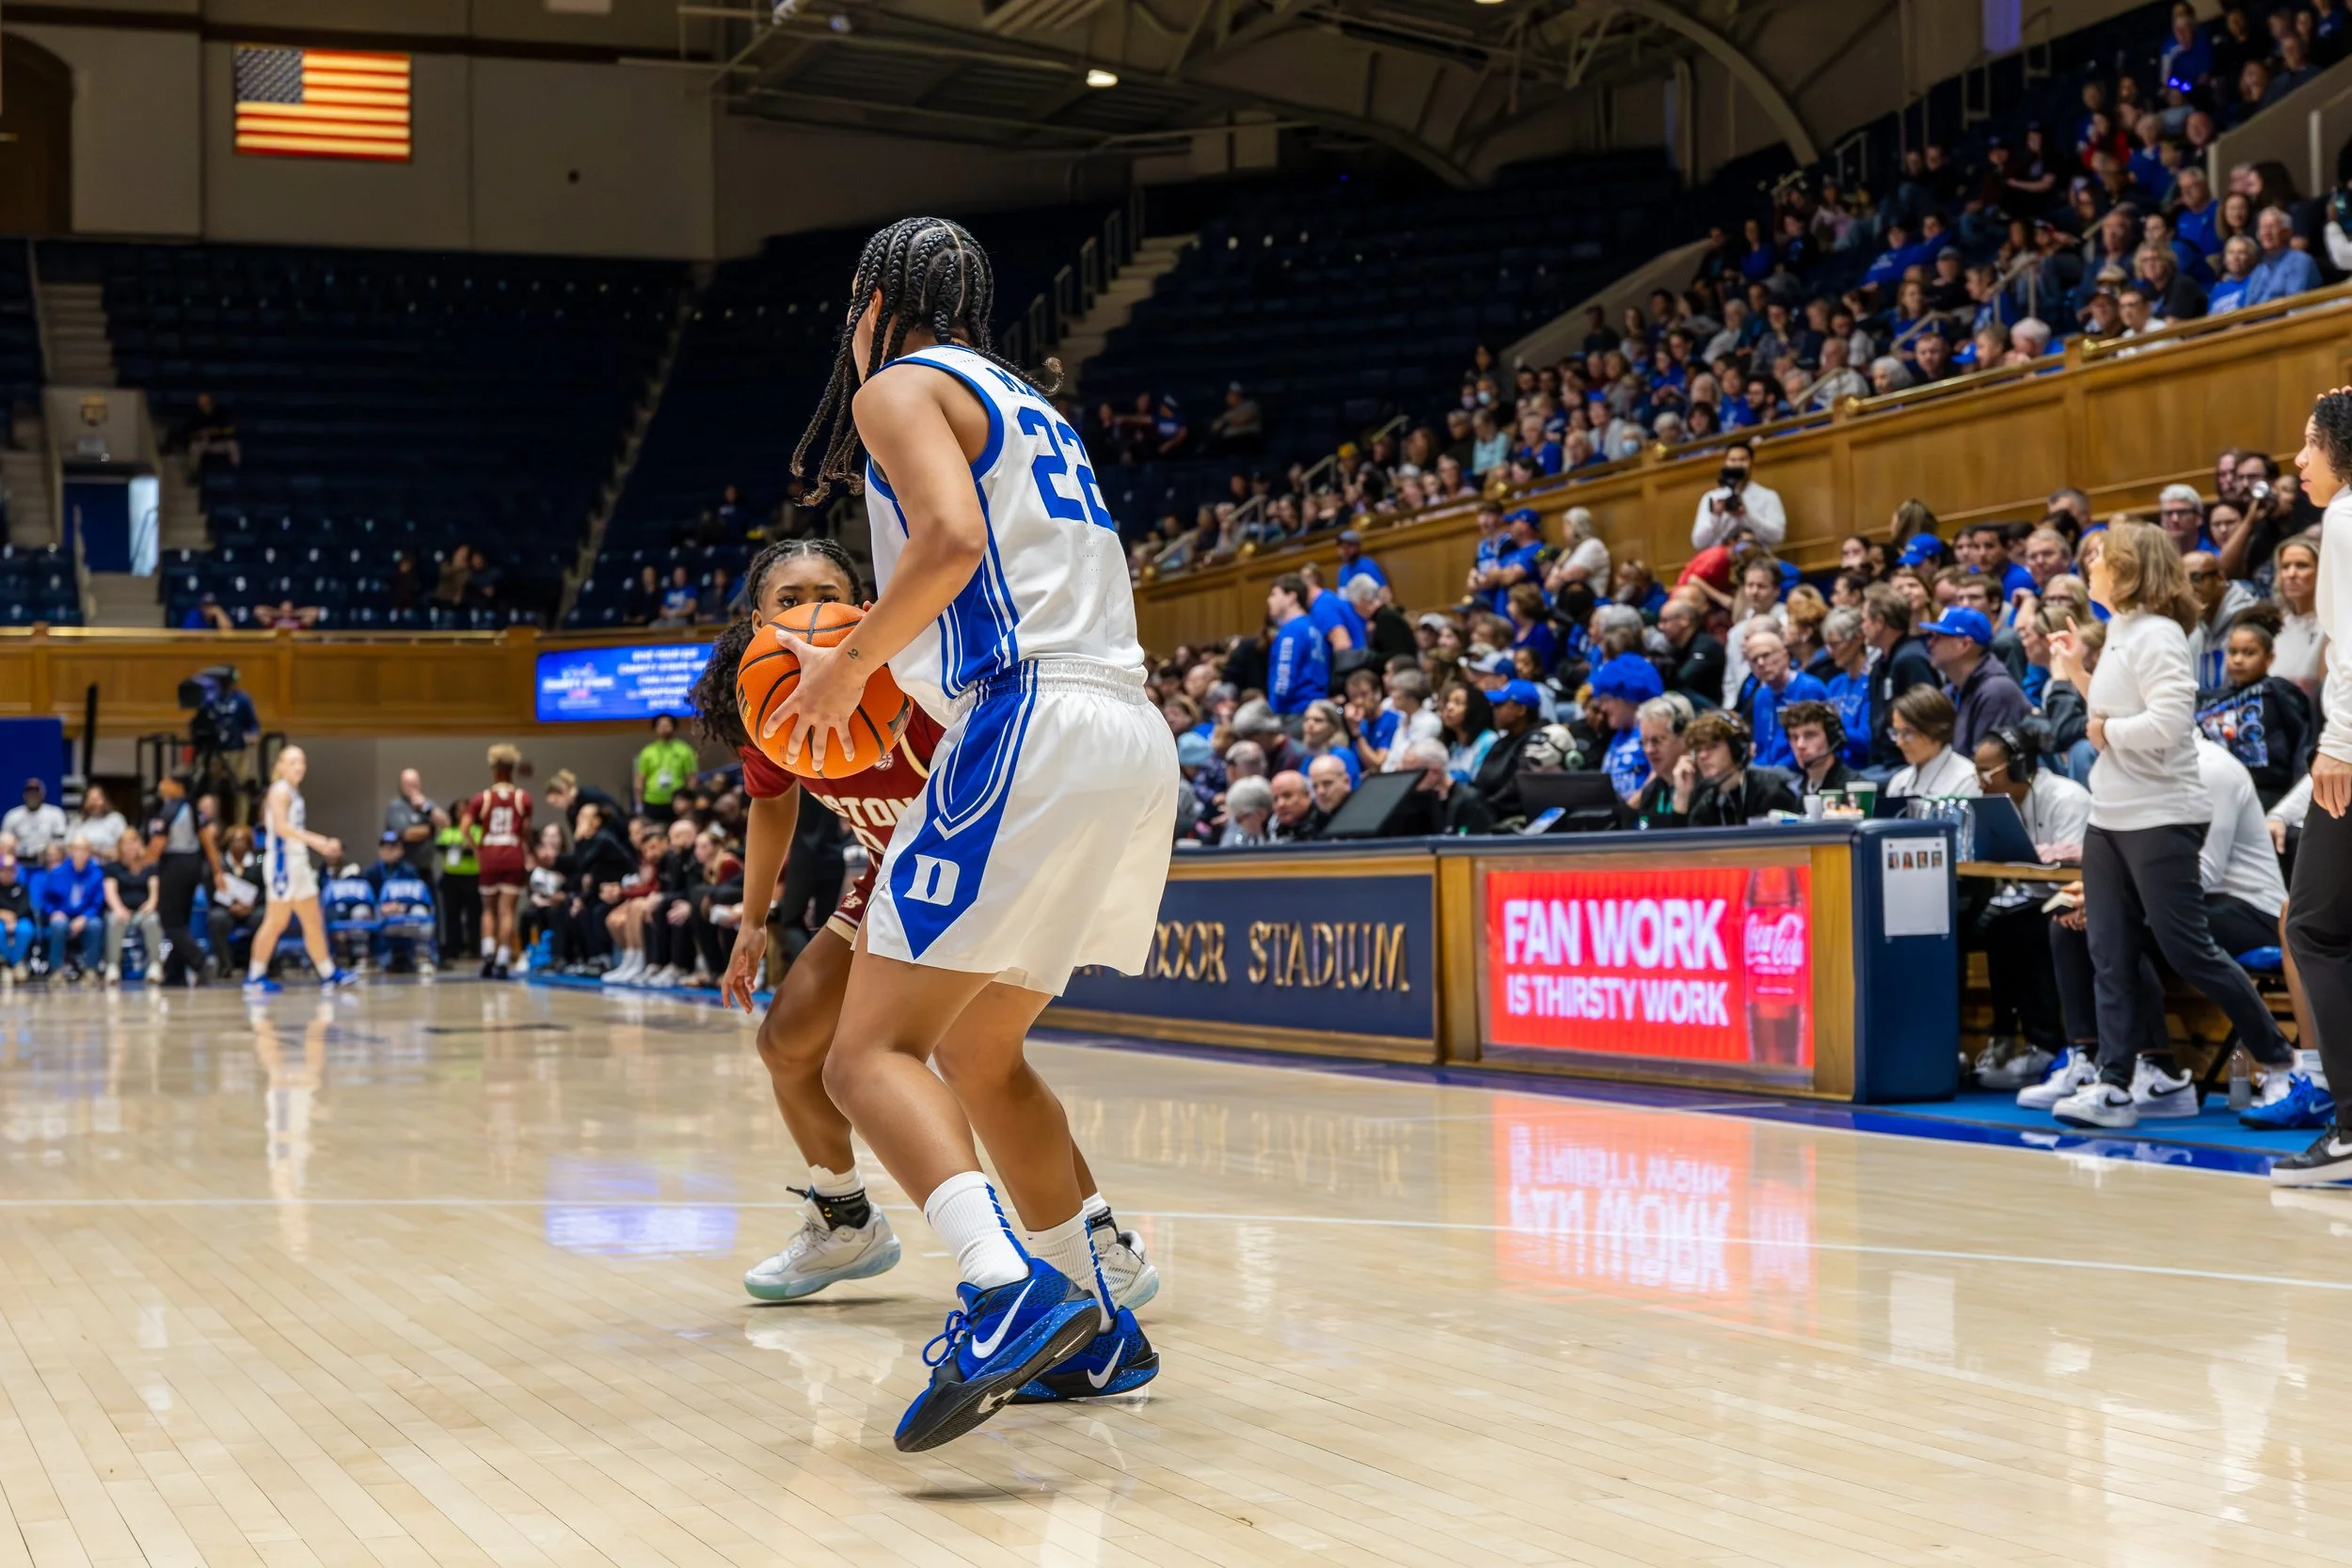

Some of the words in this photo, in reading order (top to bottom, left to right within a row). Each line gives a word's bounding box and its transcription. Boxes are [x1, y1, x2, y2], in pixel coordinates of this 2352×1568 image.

[1016, 405, 1119, 534] 22
[903, 853, 961, 907] D
[1141, 919, 1228, 984] DOOR
[1504, 898, 1581, 967] FAN
[1586, 897, 1728, 971] WORK
[1506, 974, 1532, 1016] IS
[1533, 974, 1637, 1022] THIRSTY
[1640, 980, 1730, 1027] WORK
